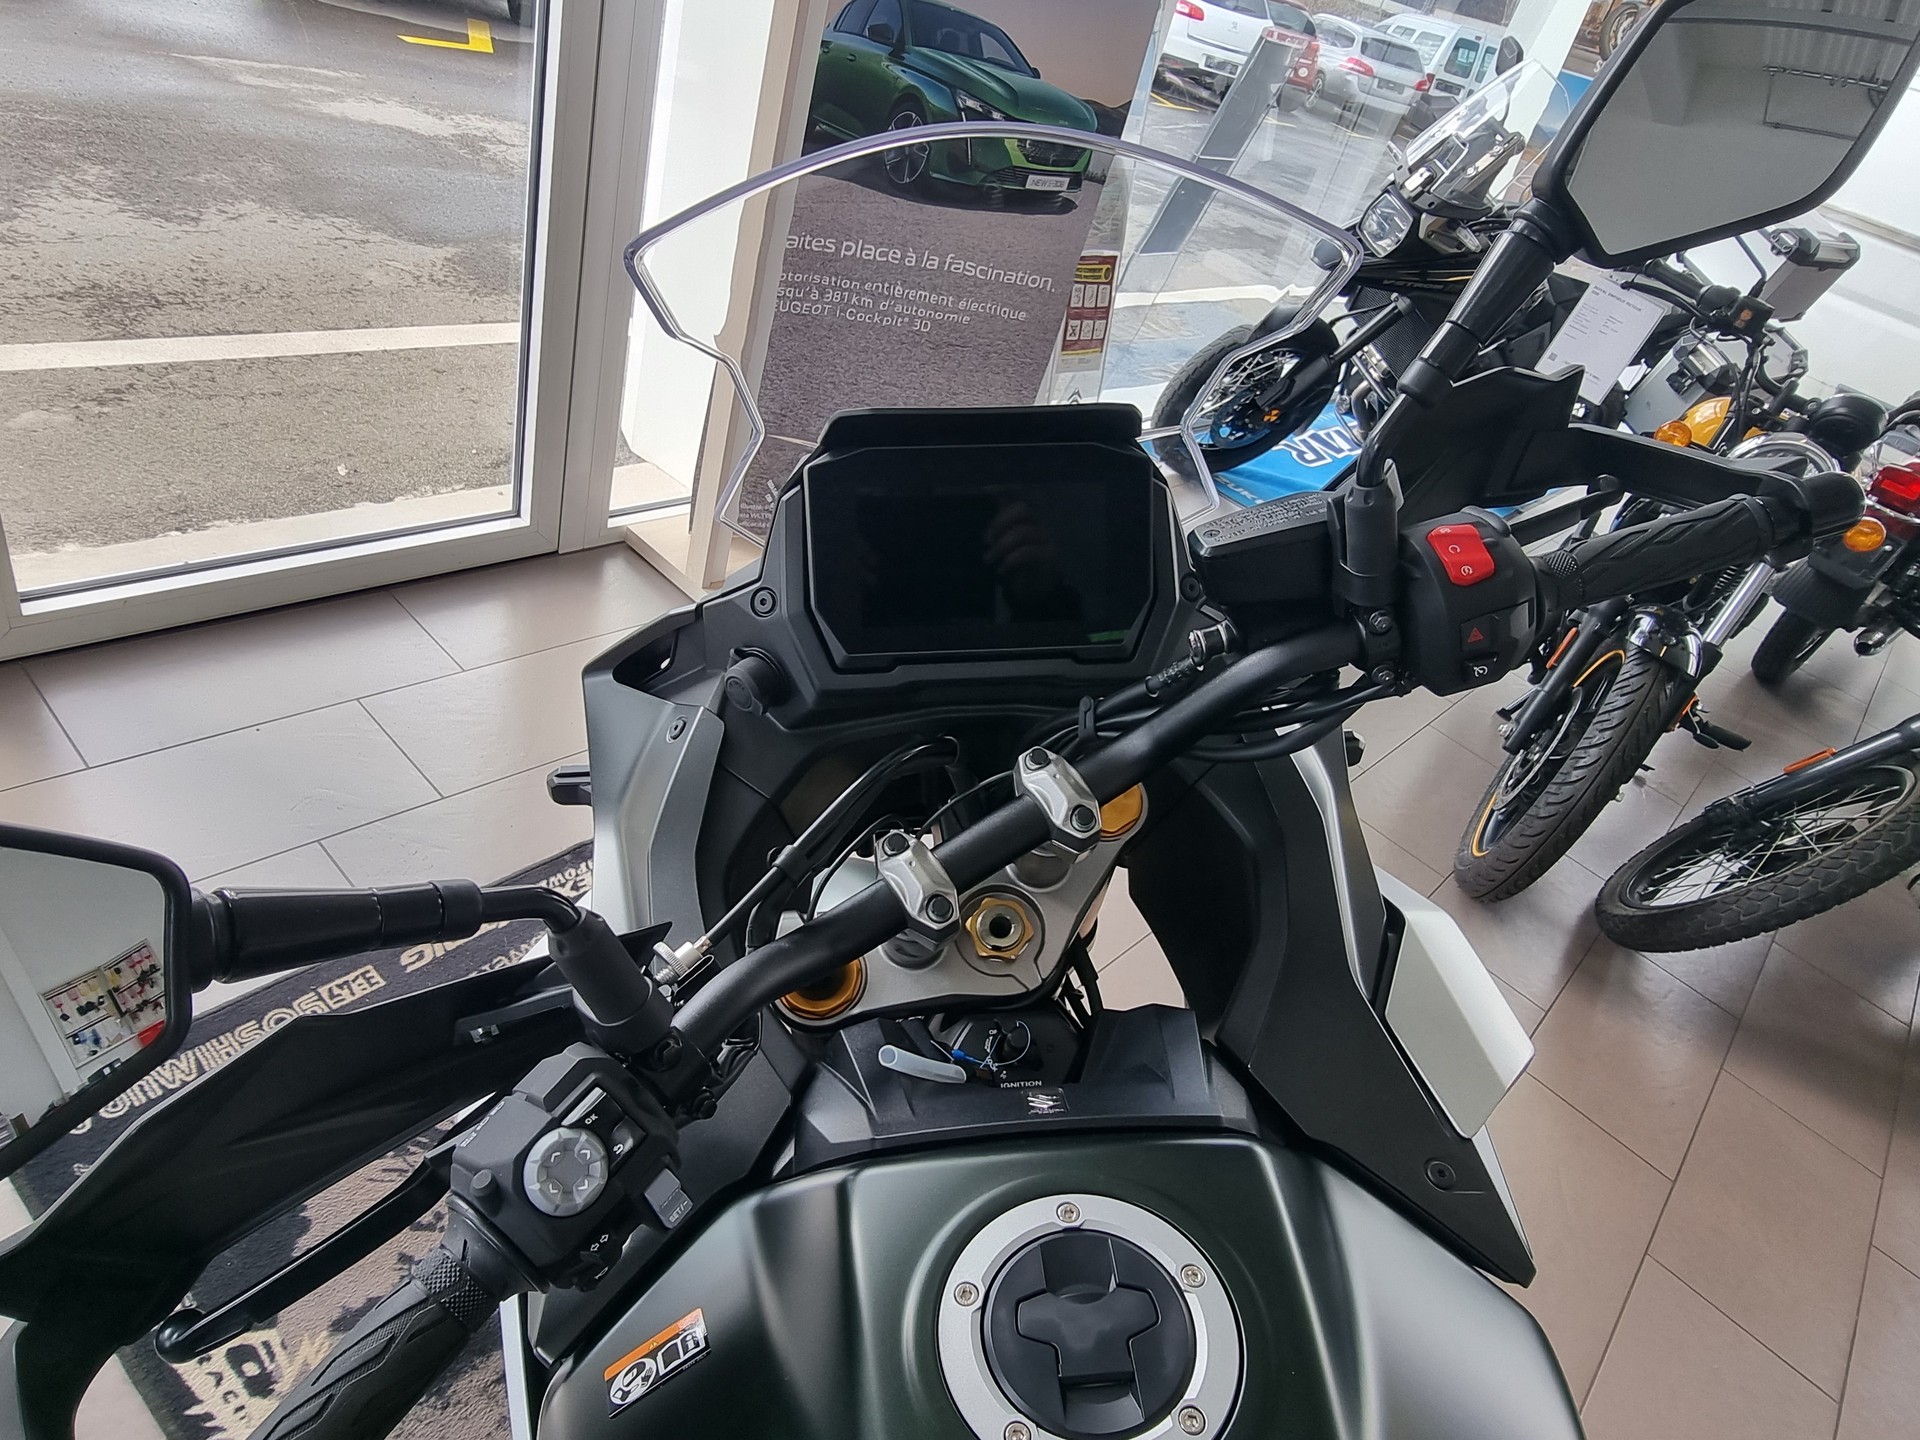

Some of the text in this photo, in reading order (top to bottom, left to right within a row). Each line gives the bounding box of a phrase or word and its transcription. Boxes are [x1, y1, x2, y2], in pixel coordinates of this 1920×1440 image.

[840, 239, 900, 264] place
[904, 247, 916, 267] à
[921, 250, 940, 270] la
[943, 253, 1056, 293] fascination.
[774, 299, 832, 316] UGEOT
[912, 318, 932, 332] 3D
[823, 288, 849, 303] 381
[851, 293, 873, 309] km
[879, 299, 971, 325] d'autonomie
[864, 280, 954, 308] entièrement
[958, 298, 1027, 321] électrique
[1000, 1080, 1042, 1089] IGNITION
[584, 1113, 599, 1125] OK
